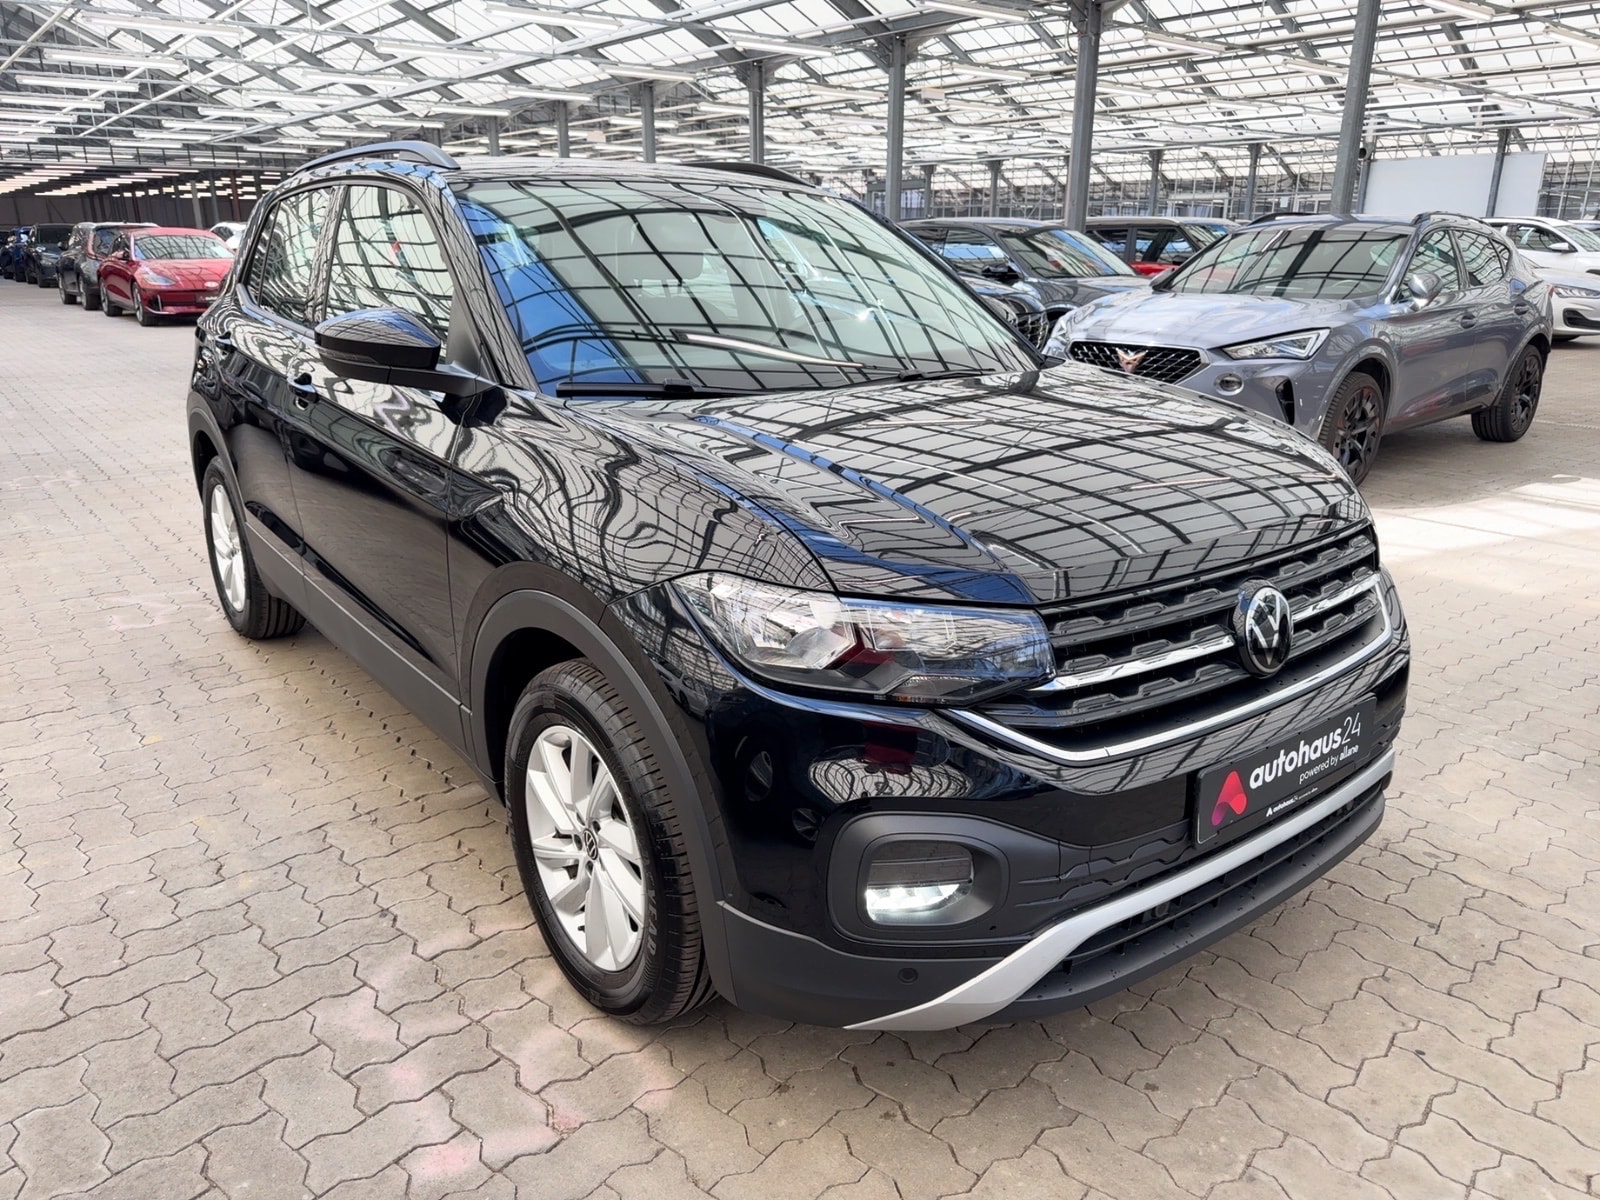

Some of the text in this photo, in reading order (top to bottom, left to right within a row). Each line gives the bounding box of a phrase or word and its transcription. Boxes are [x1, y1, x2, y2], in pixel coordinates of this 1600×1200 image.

[1249, 711, 1361, 790] autohaus24
[1299, 744, 1360, 785] powered by allane
